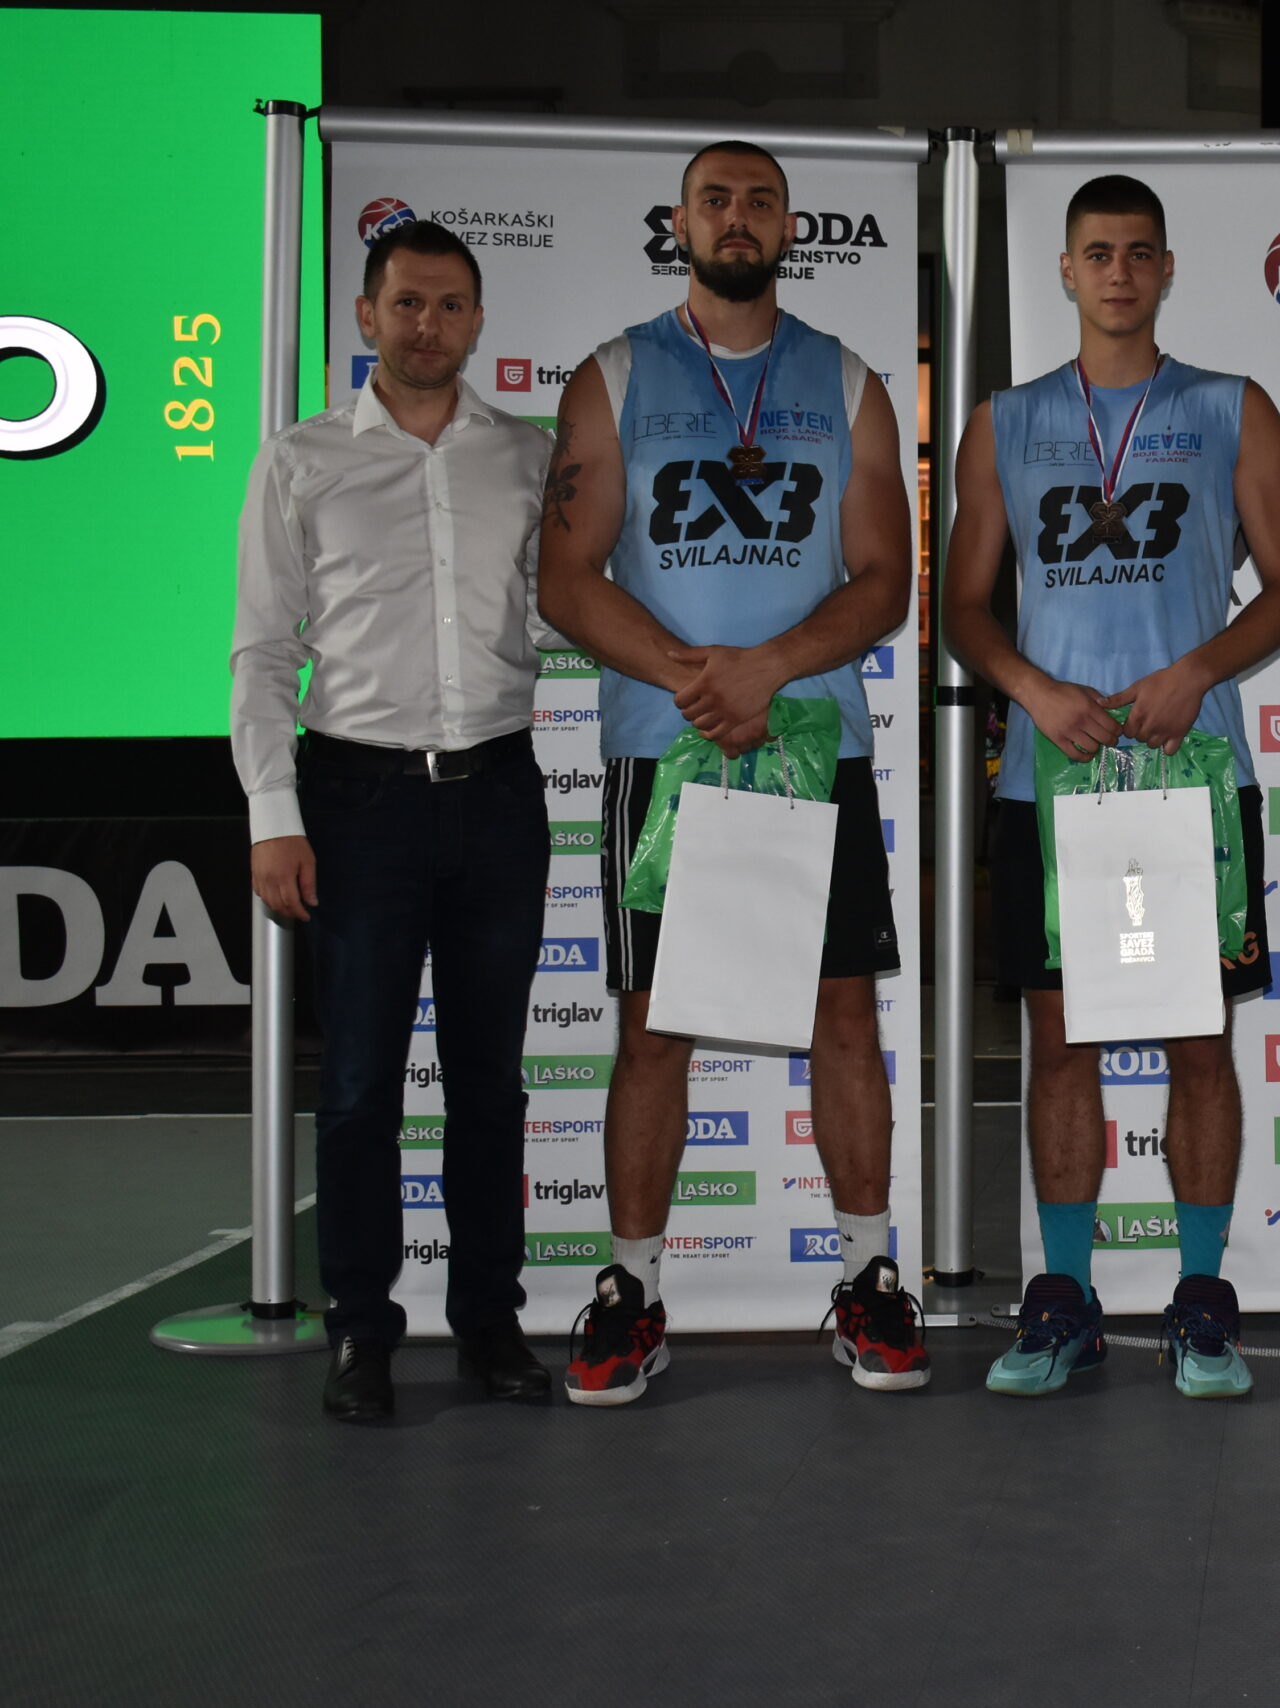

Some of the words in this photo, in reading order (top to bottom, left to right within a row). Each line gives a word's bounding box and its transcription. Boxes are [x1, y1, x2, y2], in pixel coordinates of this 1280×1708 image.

[430, 209, 553, 228] KOŠARKAŠKI
[493, 233, 553, 247] SRBIJE
[777, 266, 816, 280] BIJE
[164, 313, 221, 462] 1825
[759, 408, 833, 433] NEVEN
[1133, 430, 1202, 451] NEVEN
[659, 543, 802, 571] SVILAJNAC
[1044, 563, 1166, 589] SVILAJNAC
[543, 655, 595, 670] AŠKO
[533, 710, 601, 722] ERSPORT
[544, 769, 604, 794] riglav
[0, 860, 251, 1007] DA
[532, 1002, 603, 1028] triglav
[534, 1065, 594, 1083] LAŠKO
[524, 1121, 601, 1134] TERSPORT
[534, 1179, 605, 1205] triglav
[678, 1181, 737, 1199] LAŠKO
[1117, 1215, 1180, 1243] LAŠK
[536, 1242, 596, 1260] LAŠKO
[663, 1237, 752, 1249] NTERSPORT
